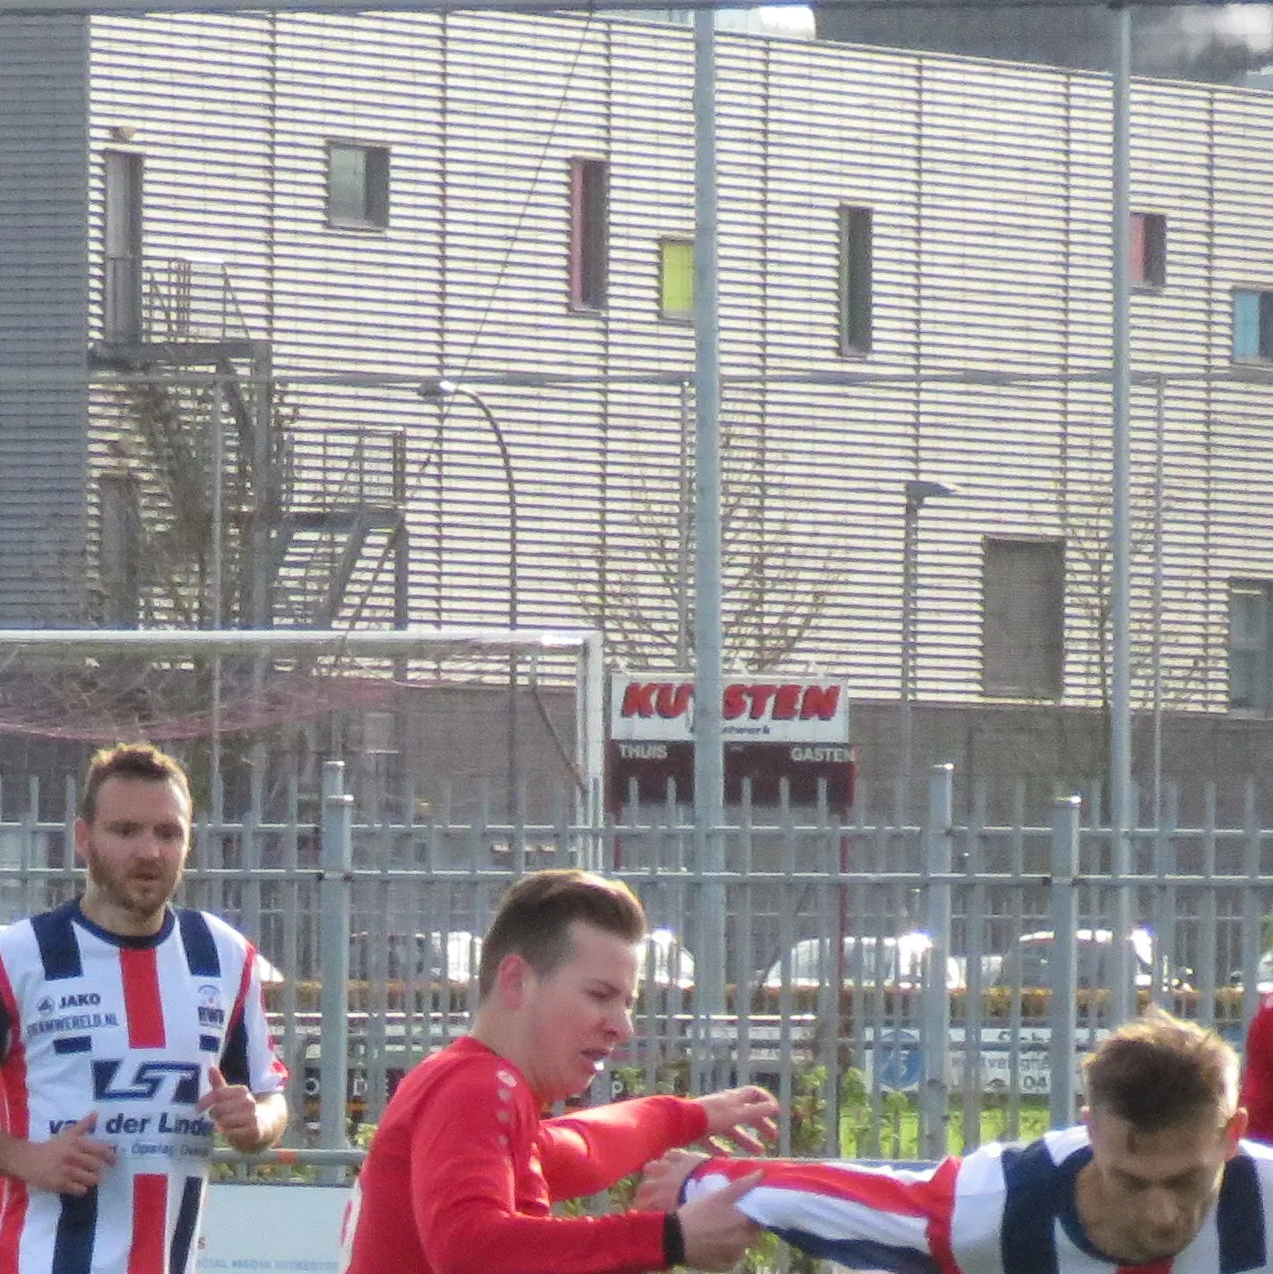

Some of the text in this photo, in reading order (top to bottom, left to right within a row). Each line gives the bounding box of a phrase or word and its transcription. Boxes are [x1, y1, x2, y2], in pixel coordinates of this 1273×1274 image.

[619, 744, 667, 759] THUIS
[790, 746, 856, 762] GASTEN
[59, 992, 101, 1010] JAKO
[106, 1112, 152, 1136] der
